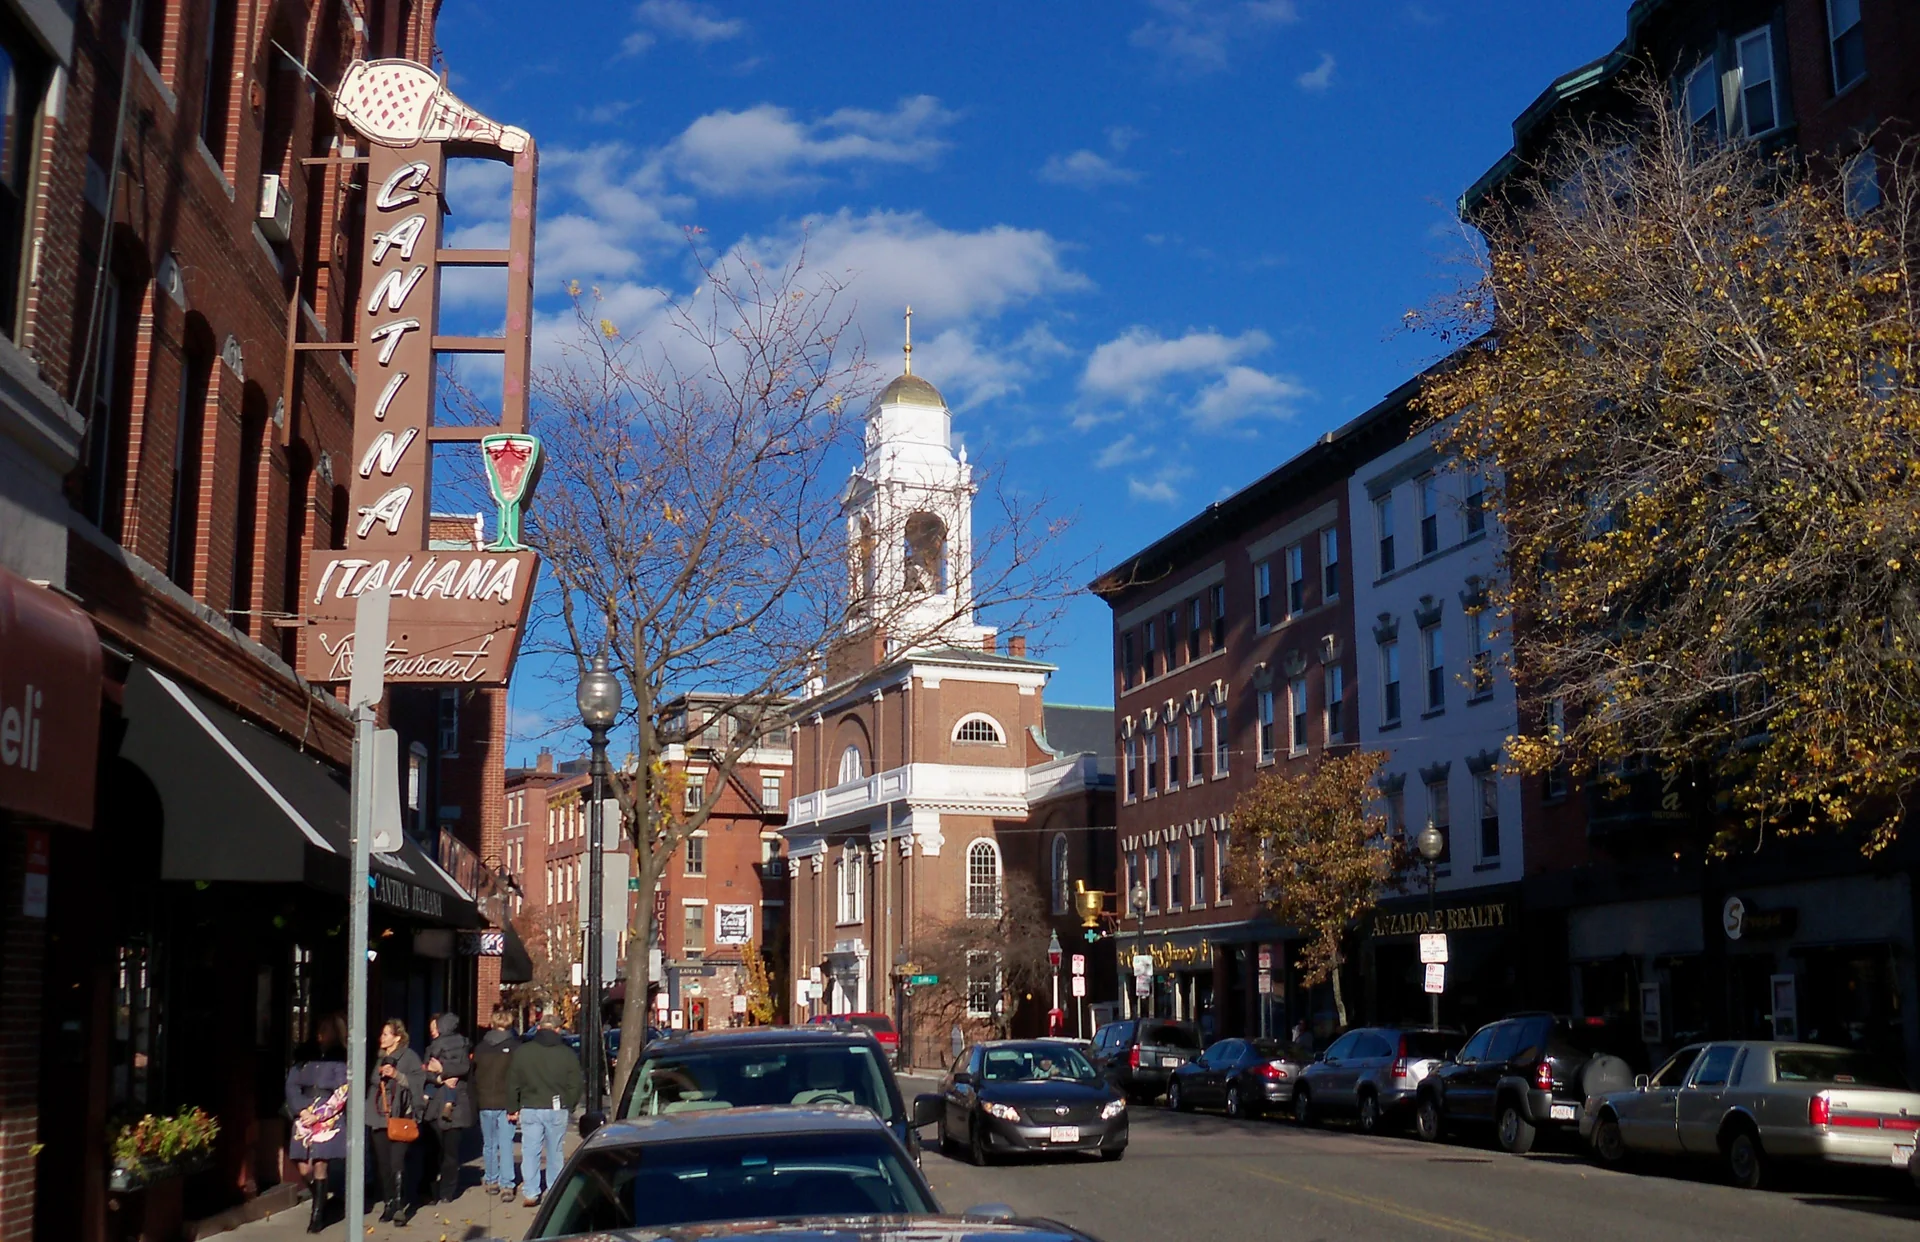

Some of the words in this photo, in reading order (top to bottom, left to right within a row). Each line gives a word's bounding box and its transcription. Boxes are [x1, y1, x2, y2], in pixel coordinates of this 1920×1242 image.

[357, 161, 431, 539] CANTINA
[313, 554, 520, 605] ITALIANA
[319, 632, 494, 682] Rtaurant
[0, 683, 42, 772] eli
[373, 872, 409, 909] CANTINA
[412, 885, 443, 918] ITALIANA
[656, 892, 666, 941] LUCIA
[1447, 904, 1505, 931] REALTY
